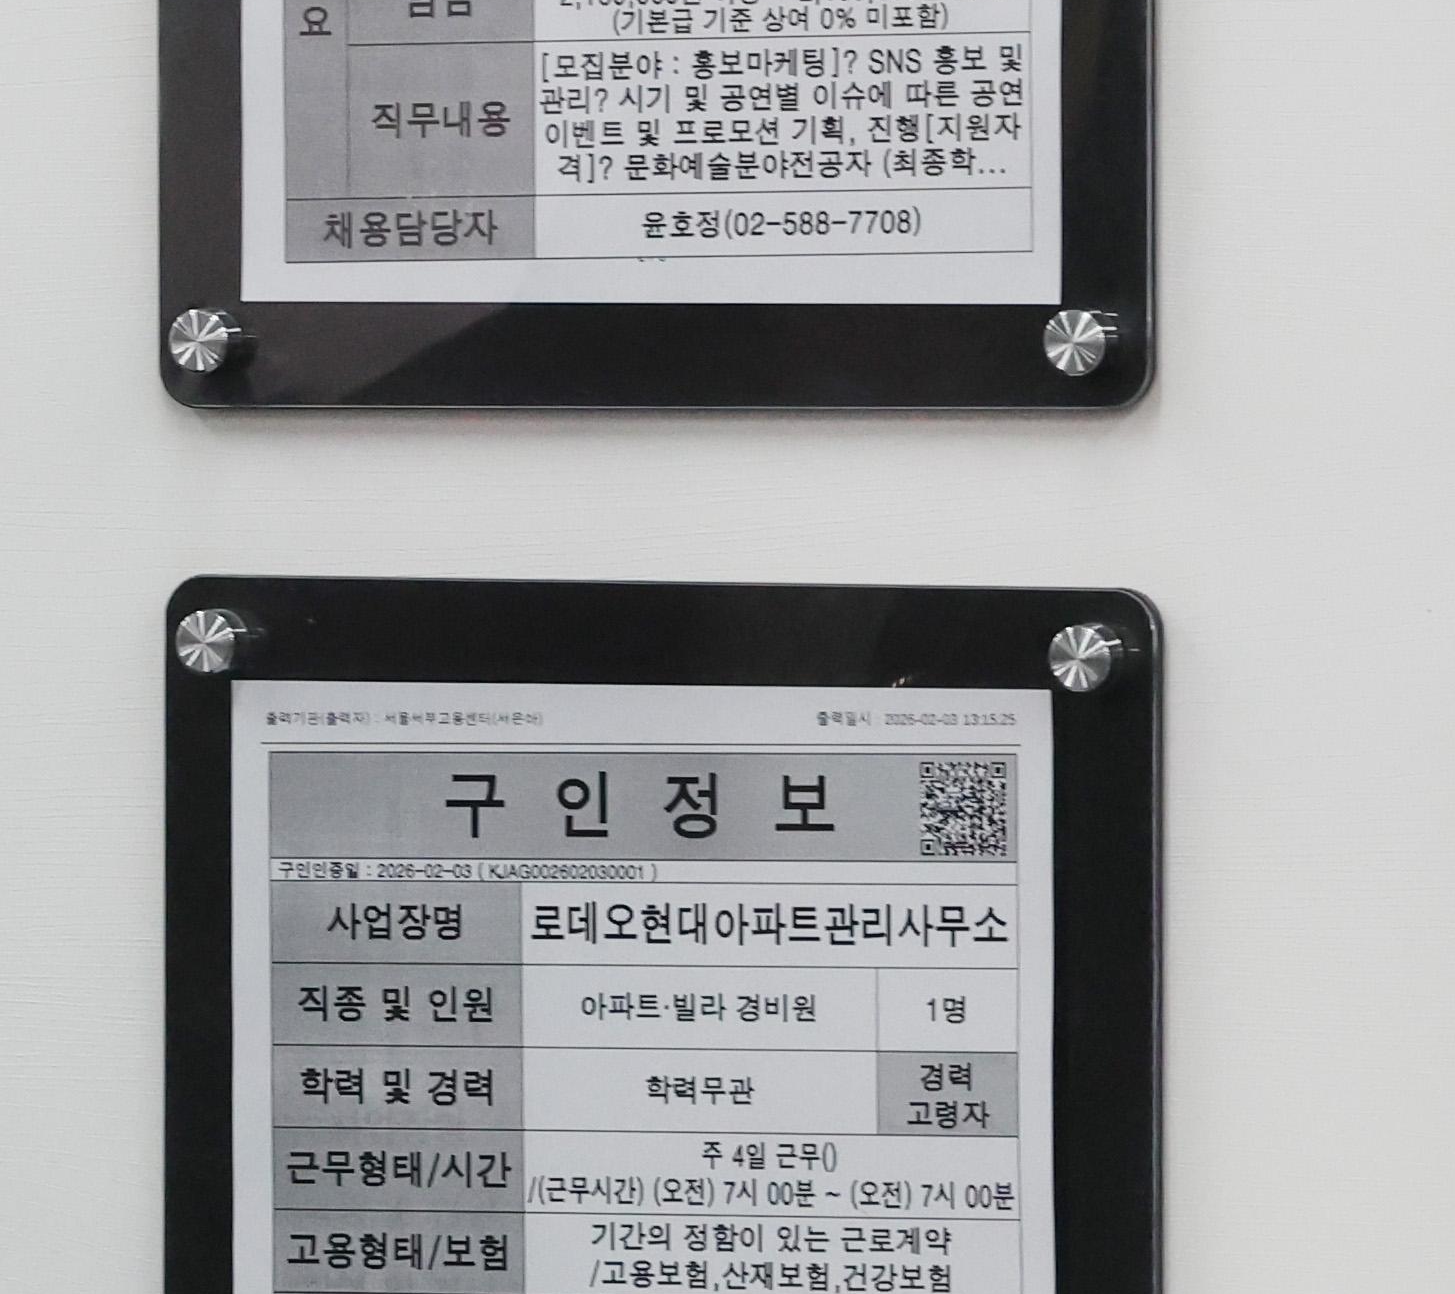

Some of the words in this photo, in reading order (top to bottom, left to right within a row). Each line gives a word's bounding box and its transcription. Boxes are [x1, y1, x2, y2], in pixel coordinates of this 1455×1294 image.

[641, 206, 921, 240] 윤호정(02-588-7708)
[530, 901, 1009, 948] 로데오현대아파트관리사무소
[581, 992, 727, 1023] 아파트·빌라
[736, 994, 816, 1023] 경비원
[906, 1100, 991, 1130] 고령자
[286, 1232, 508, 1272] 고용형태/보험
